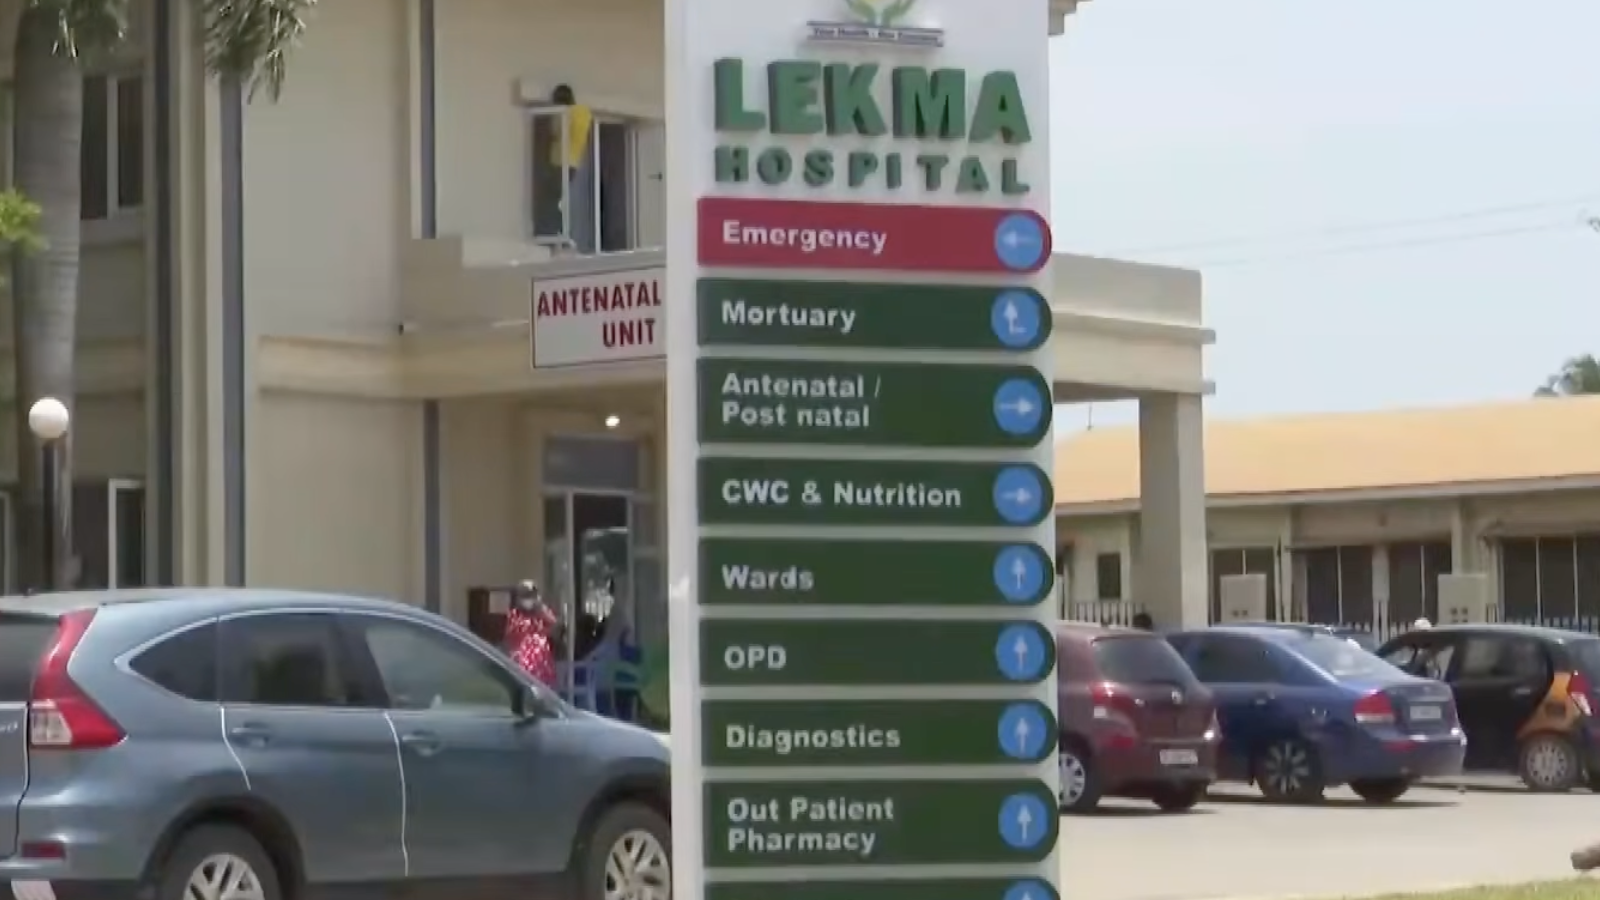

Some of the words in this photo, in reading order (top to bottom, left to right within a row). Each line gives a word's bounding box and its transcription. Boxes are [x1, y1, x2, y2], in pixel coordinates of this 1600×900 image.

[714, 58, 1031, 143] LEKMA
[714, 146, 1030, 194] HOSPITAL
[722, 220, 887, 254] Emergency
[537, 279, 661, 317] ANTENATAL
[721, 300, 856, 334] Mortuary
[602, 317, 655, 348] UNIT
[721, 372, 864, 398] Antenatal
[721, 400, 787, 426] Post
[797, 404, 870, 427] natal
[721, 479, 789, 504] CWC
[801, 481, 822, 504] &
[833, 481, 961, 507] Nutrition
[721, 564, 814, 590] Wards
[723, 645, 787, 670] OPD
[725, 724, 901, 754] Diagnostics
[727, 797, 779, 822] Out
[790, 796, 894, 822] Patient
[727, 828, 876, 857] Pharmacy
